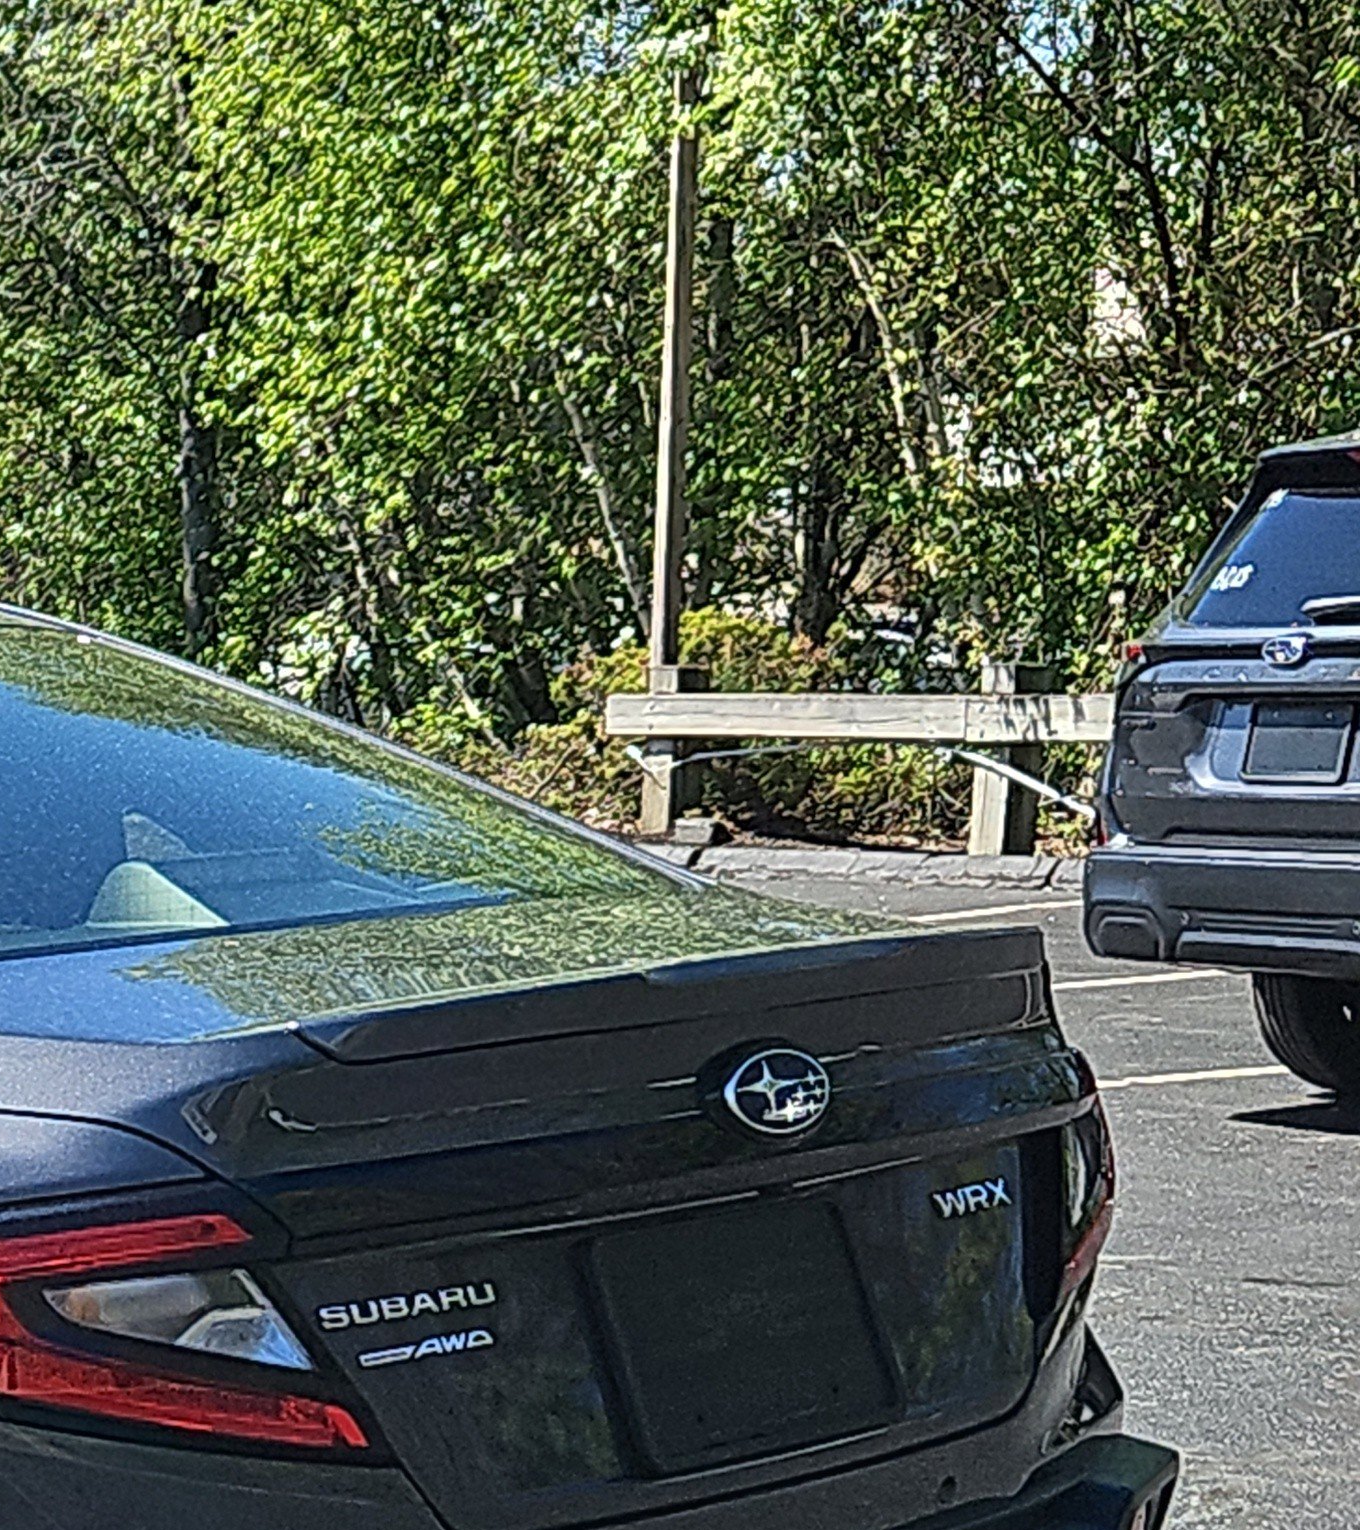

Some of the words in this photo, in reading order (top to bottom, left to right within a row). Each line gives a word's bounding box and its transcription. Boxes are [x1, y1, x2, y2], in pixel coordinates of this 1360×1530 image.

[932, 1177, 1013, 1218] WRX
[318, 1283, 496, 1330] SUBARU
[414, 1330, 494, 1360] AWD
